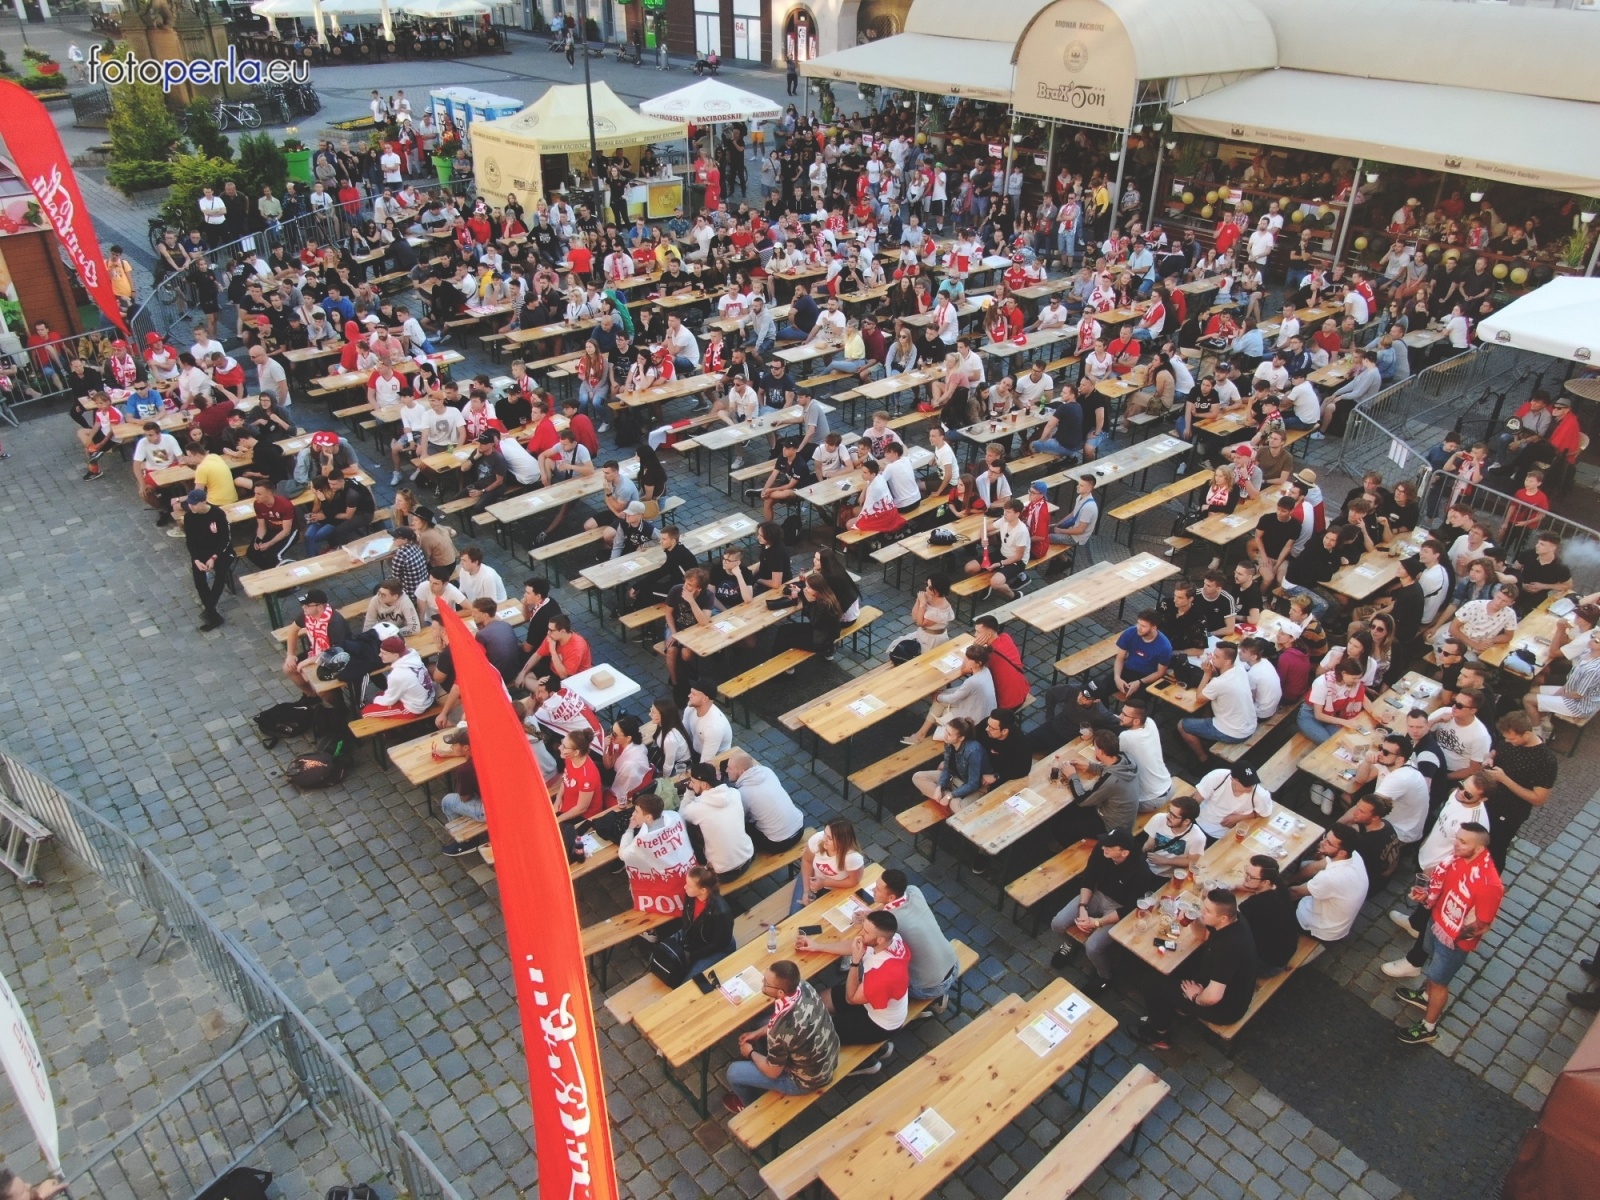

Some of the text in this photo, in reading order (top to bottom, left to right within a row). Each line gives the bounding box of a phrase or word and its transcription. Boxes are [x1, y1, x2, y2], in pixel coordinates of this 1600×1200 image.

[1055, 20, 1077, 29] BROWAR
[697, 113, 743, 122] RACIBORSKIE
[653, 834, 684, 859] na TY
[1067, 1001, 1078, 1012] 1
